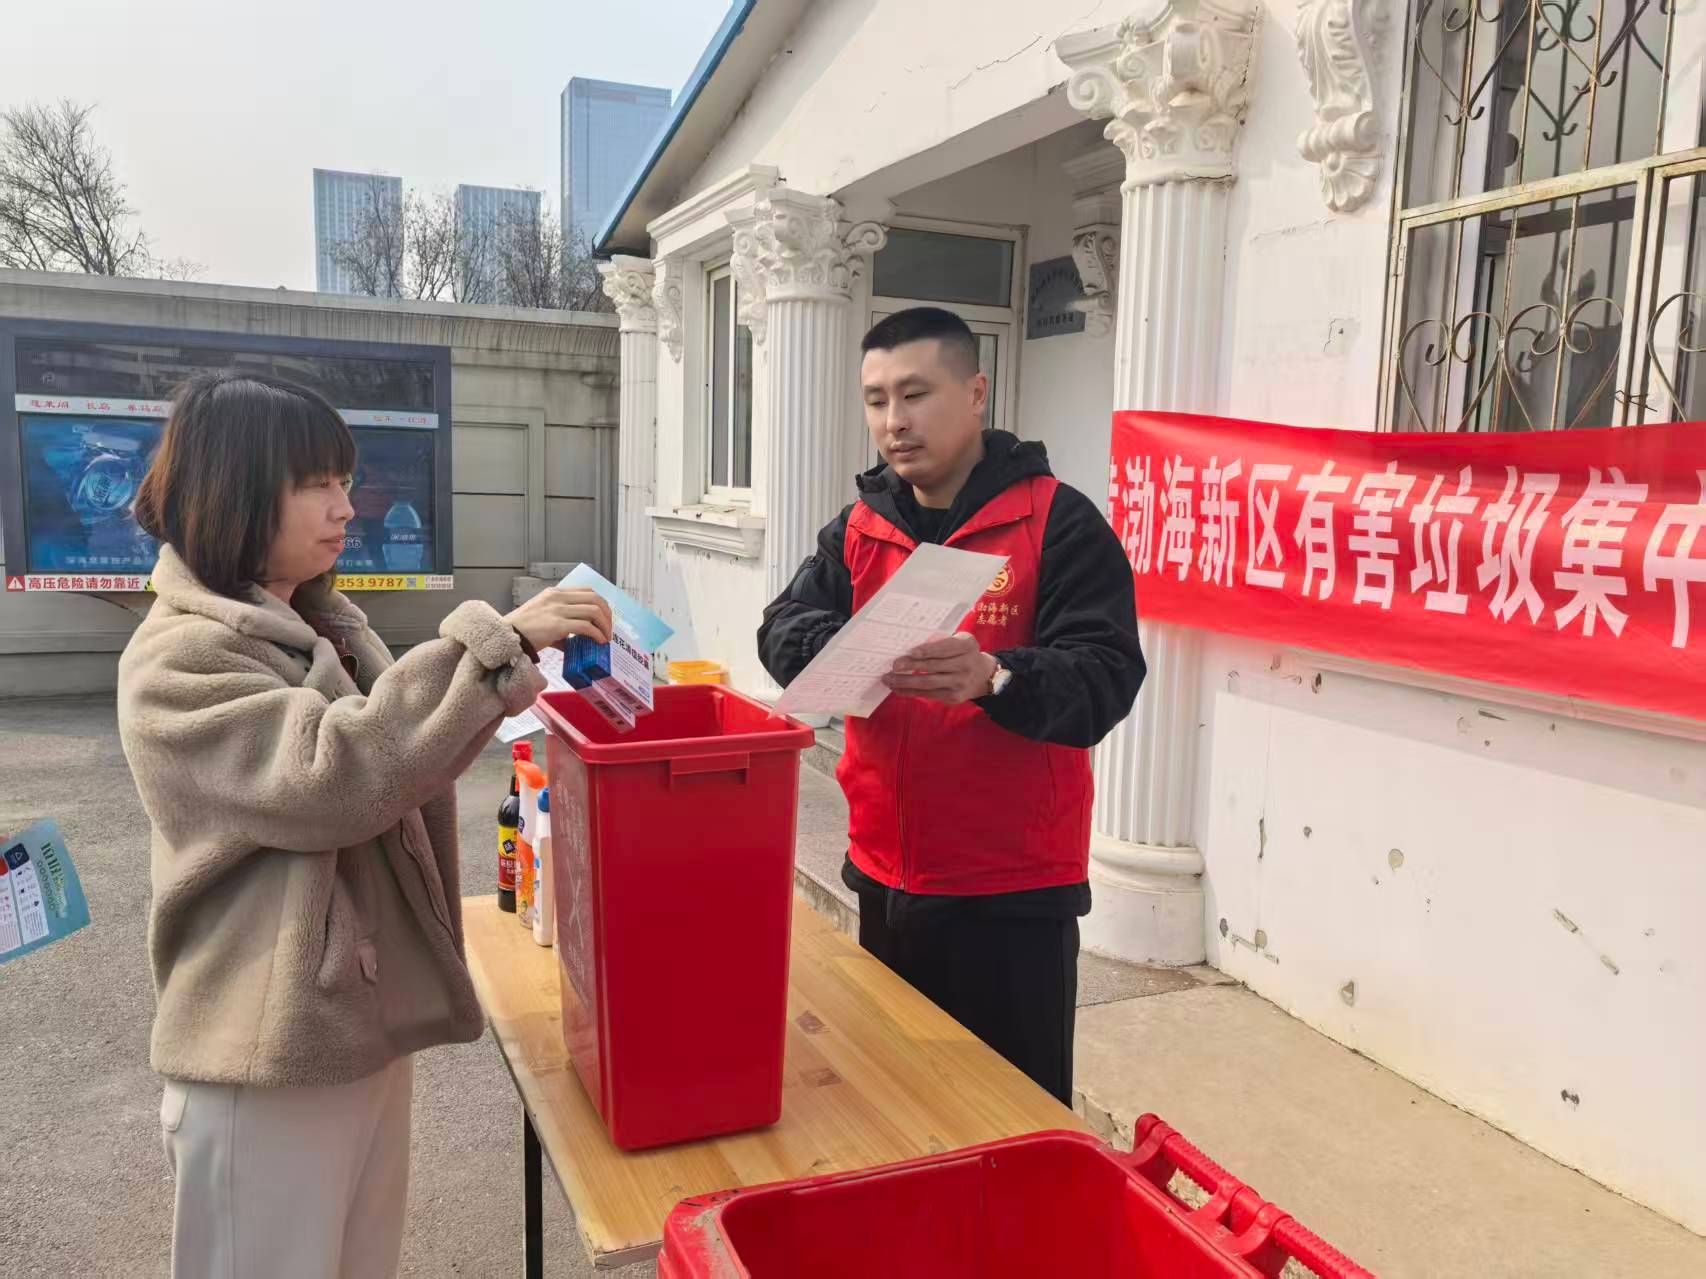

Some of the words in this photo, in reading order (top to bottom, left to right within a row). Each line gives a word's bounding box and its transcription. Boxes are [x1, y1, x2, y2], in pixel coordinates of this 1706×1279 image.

[28, 576, 141, 590] 高压危险请勿靠近
[972, 602, 1019, 616] 渤海新区
[976, 612, 1008, 627] 志愿者
